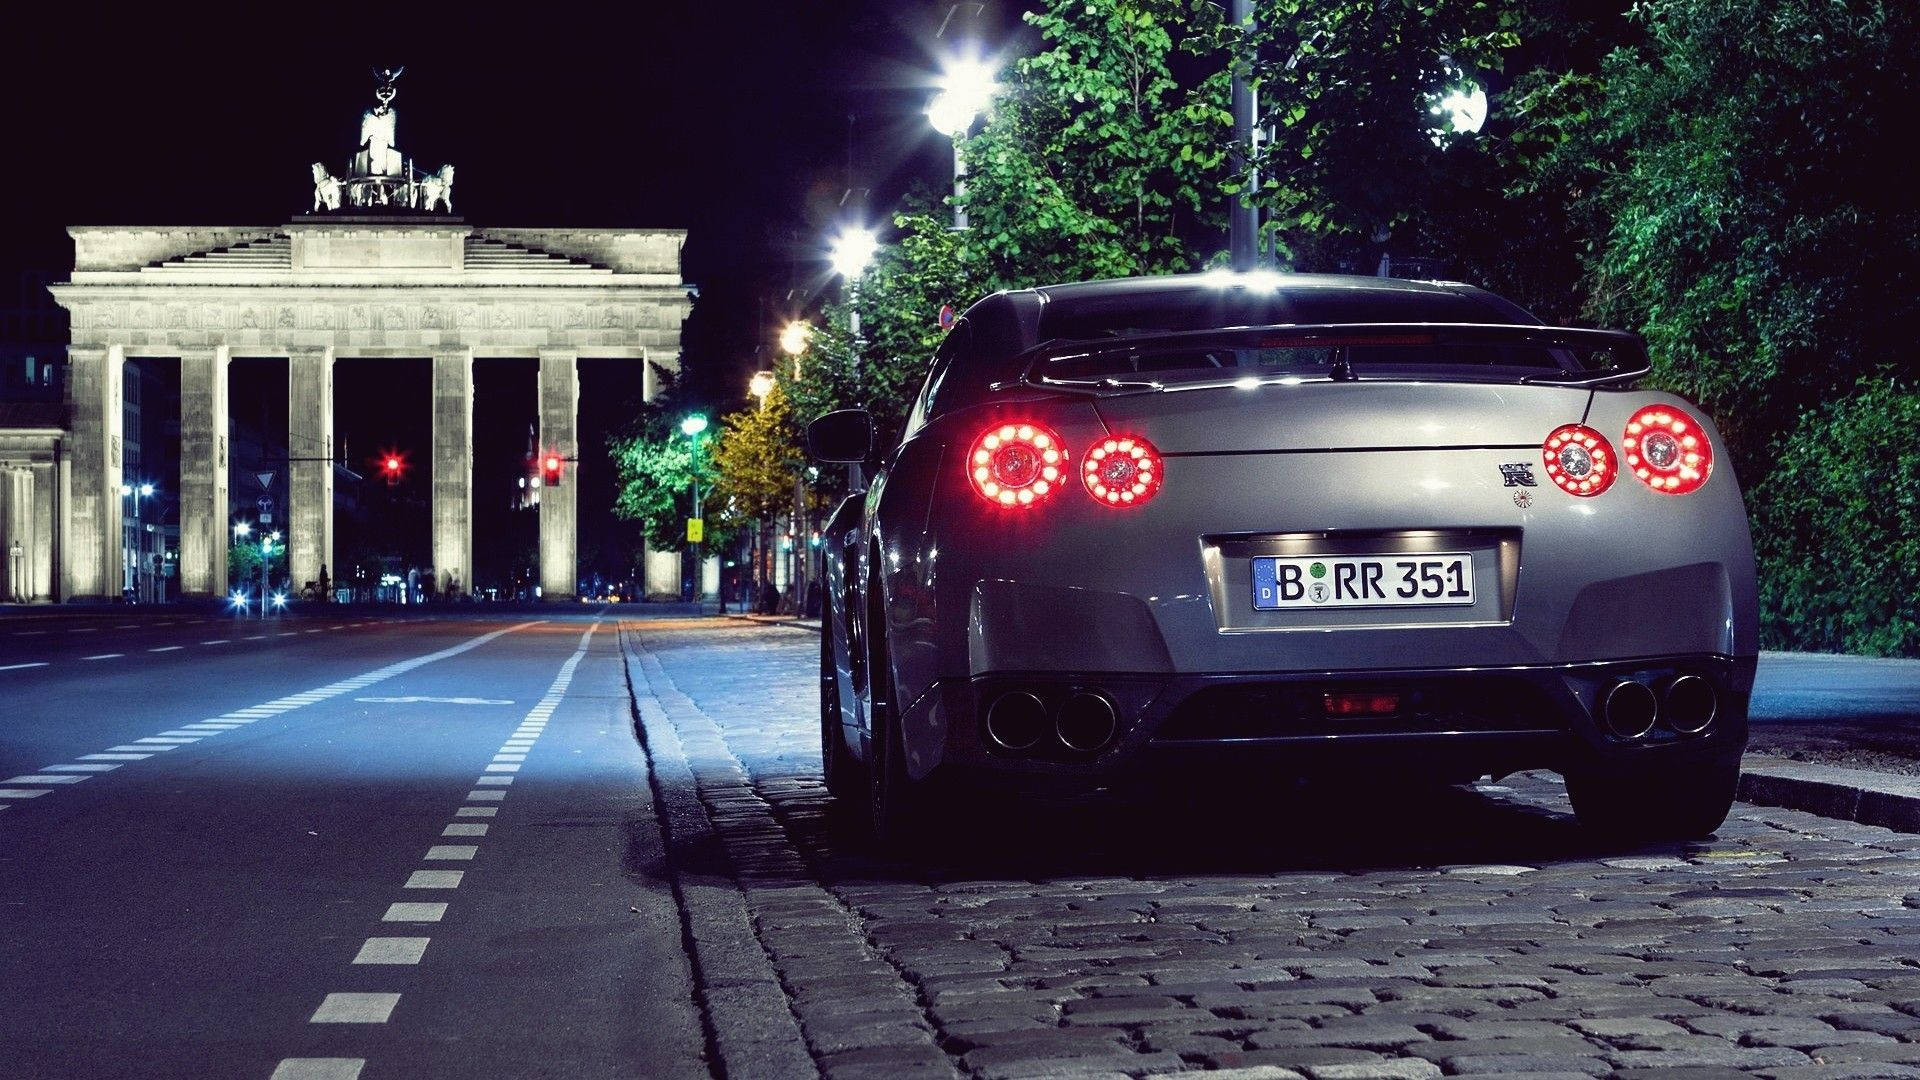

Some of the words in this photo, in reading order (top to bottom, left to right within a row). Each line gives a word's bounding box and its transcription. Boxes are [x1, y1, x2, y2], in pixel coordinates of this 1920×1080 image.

[1261, 587, 1272, 599] D
[1279, 564, 1305, 600] B
[1334, 562, 1387, 599] RR
[1396, 560, 1470, 598] 351
